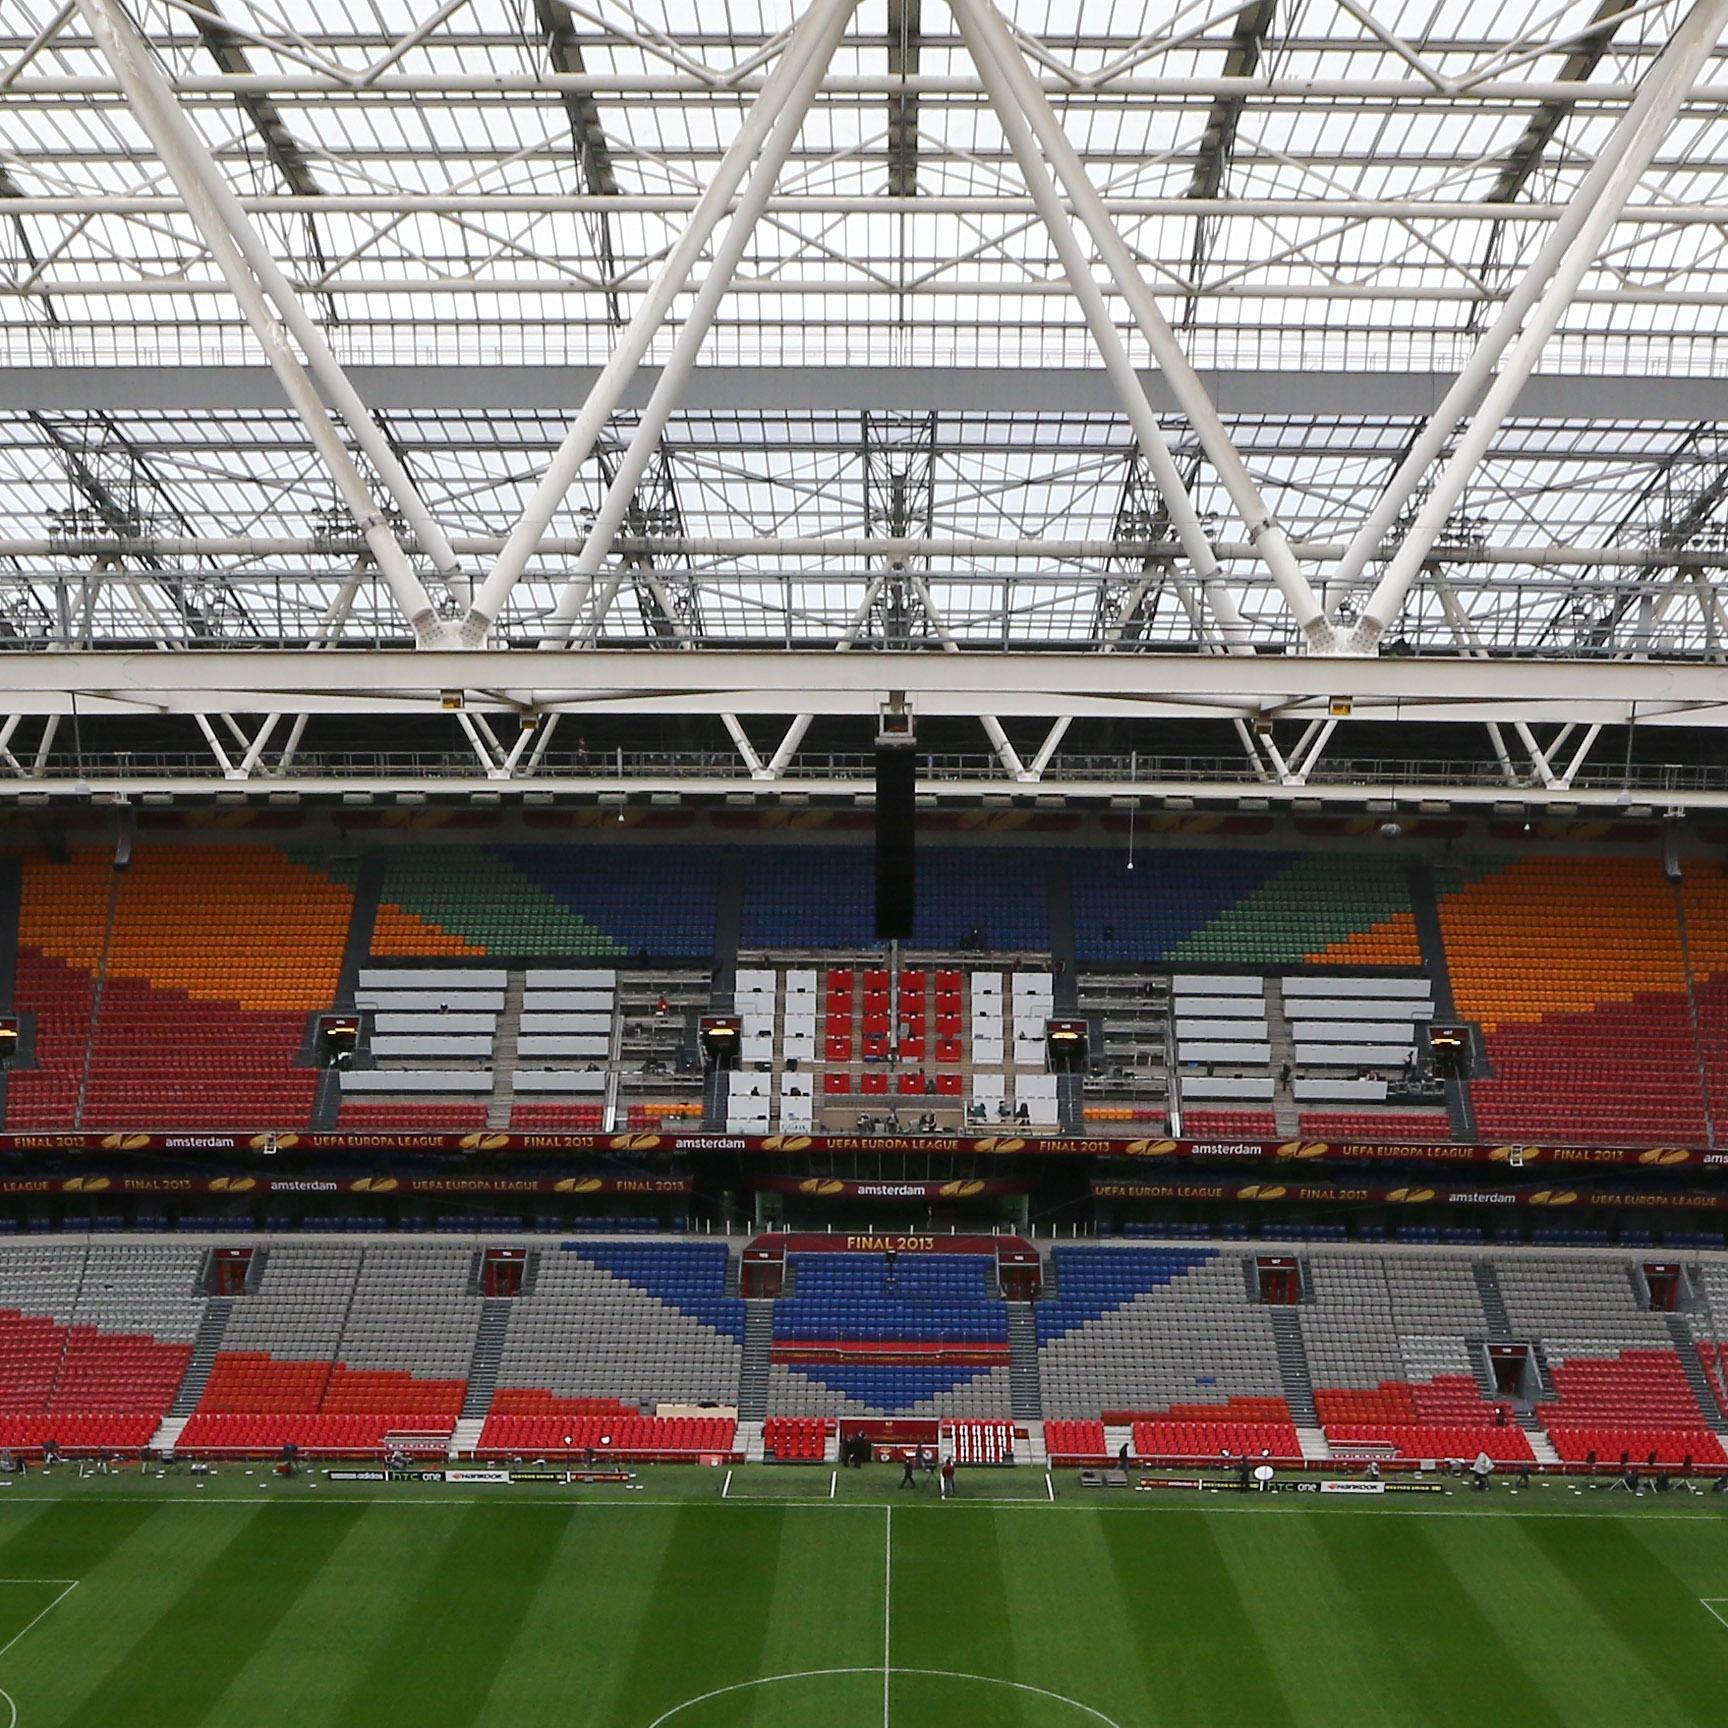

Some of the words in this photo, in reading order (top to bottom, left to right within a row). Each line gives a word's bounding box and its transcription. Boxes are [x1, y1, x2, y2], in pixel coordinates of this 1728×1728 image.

[15, 1137, 53, 1148] FINAL
[57, 1136, 86, 1147] 2013
[166, 1136, 234, 1148] amsterdam
[313, 1137, 345, 1147] UEFA
[348, 1137, 395, 1147] EUROPA
[398, 1136, 444, 1147] LEAGUE
[524, 1137, 562, 1147] FINAL
[565, 1136, 594, 1147] 2013
[675, 1137, 745, 1149] amsterdam
[827, 1139, 858, 1150] UEFA
[861, 1139, 908, 1150] EUROPA
[912, 1139, 958, 1150] LEAGUE
[1040, 1141, 1077, 1151] FINAL
[1080, 1141, 1109, 1152] 2013
[1191, 1143, 1262, 1156] amsterdam
[1343, 1146, 1374, 1156] UEFA
[1377, 1147, 1424, 1157] EUROPA
[1427, 1147, 1473, 1158] LEAGUE
[1554, 1149, 1591, 1160] FINAL
[1593, 1150, 1624, 1161] 2013
[4, 1181, 49, 1192] LEAGUE
[124, 1180, 160, 1191] FINAL
[163, 1180, 191, 1190] 2013
[271, 1180, 337, 1191] amsterdam
[412, 1181, 443, 1191] UEFA
[445, 1181, 492, 1191] EUROPA
[494, 1181, 539, 1191] LEAGUE
[616, 1181, 653, 1191] FINAL
[656, 1181, 684, 1192] 2013
[857, 1184, 926, 1196] amsterdam
[1096, 1186, 1125, 1196] UEFA
[1128, 1187, 1173, 1197] EUROPA
[1177, 1187, 1222, 1198] LEAGUE
[1300, 1188, 1336, 1199] FINAL
[1339, 1189, 1368, 1200] 2013
[1448, 1191, 1515, 1204] amsterdam
[1591, 1194, 1622, 1205] UEFA
[1623, 1195, 1670, 1206] EUROPA
[1672, 1196, 1716, 1206] LEAGUE
[847, 1236, 893, 1250] FINAL
[897, 1237, 934, 1250] 2013
